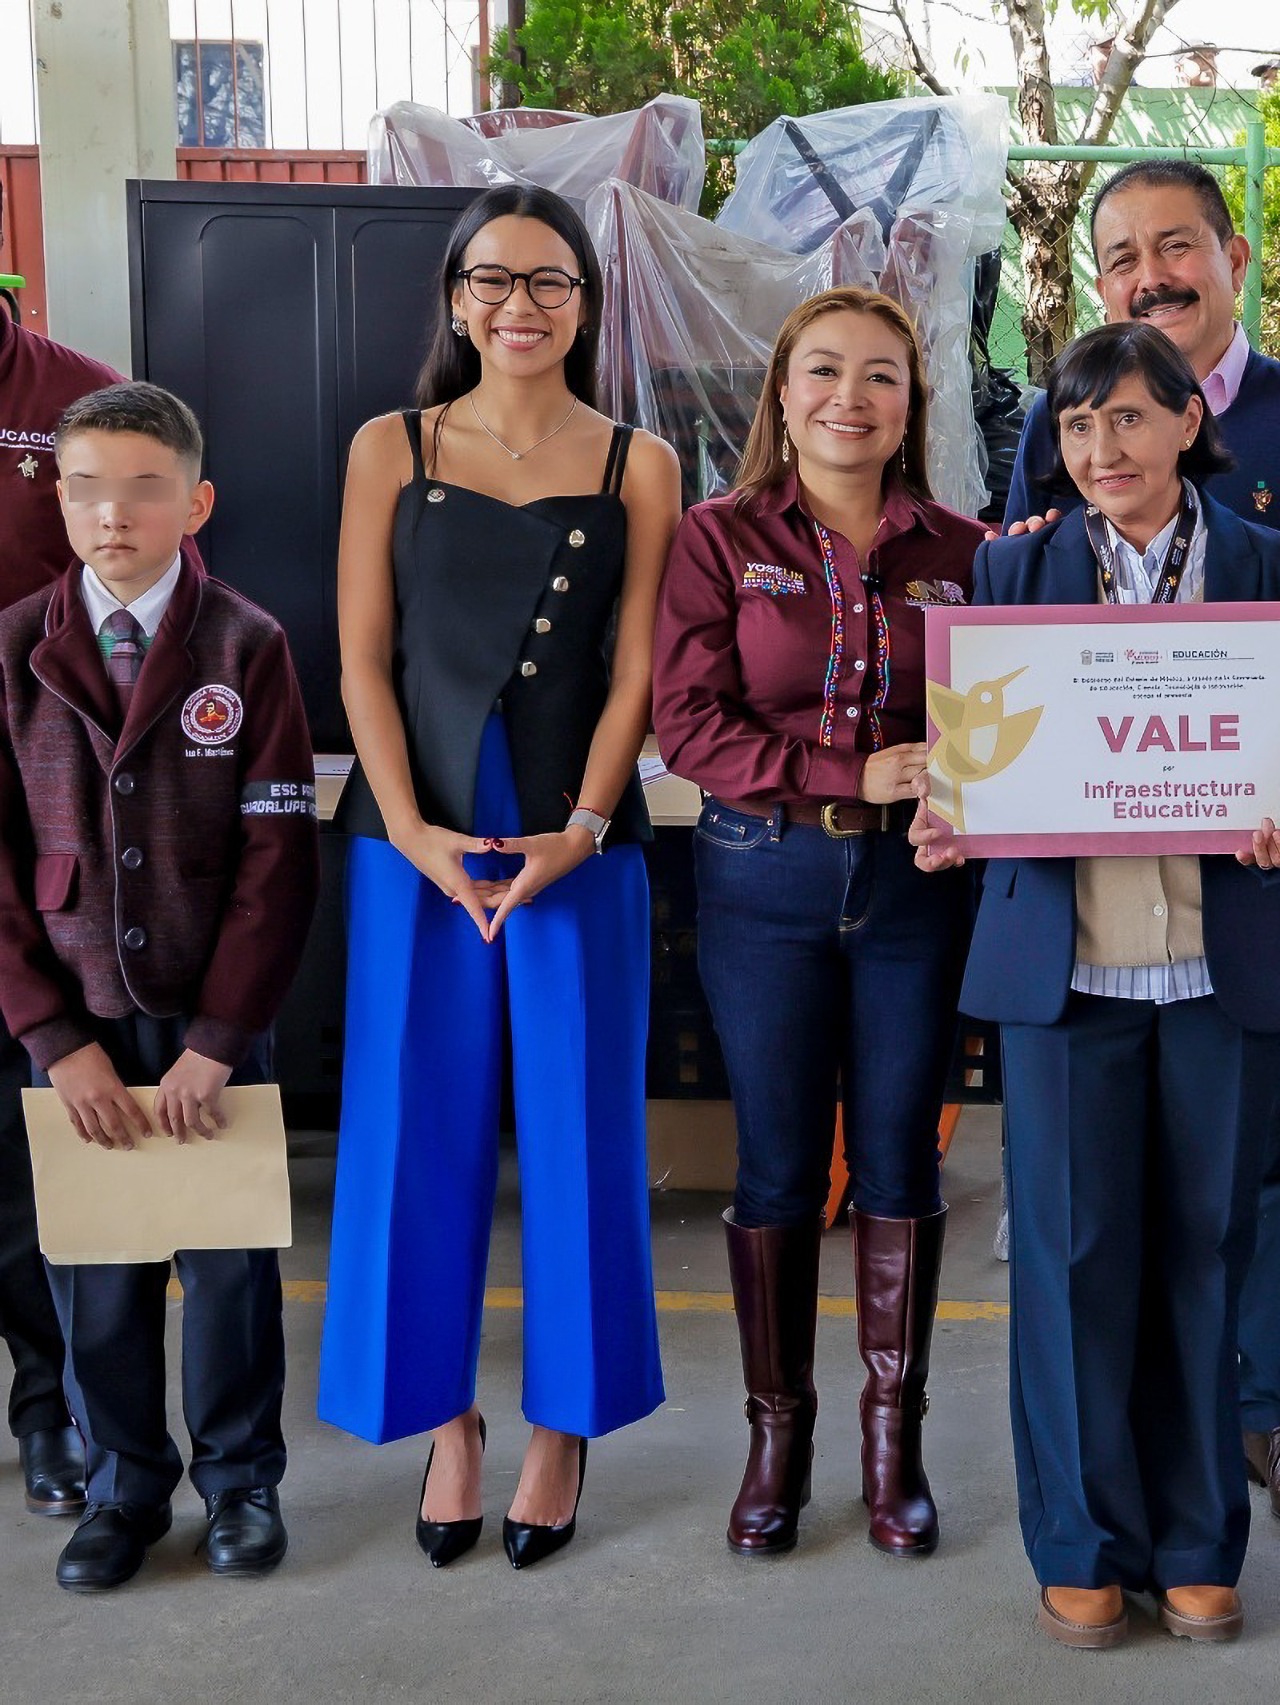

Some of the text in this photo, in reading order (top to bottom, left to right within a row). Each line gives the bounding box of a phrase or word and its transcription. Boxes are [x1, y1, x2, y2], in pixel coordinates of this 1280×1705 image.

[1097, 714, 1241, 753] VALE
[270, 783, 298, 797] ESC
[1084, 780, 1256, 799] Infraestructura
[1113, 799, 1228, 819] Educativa
